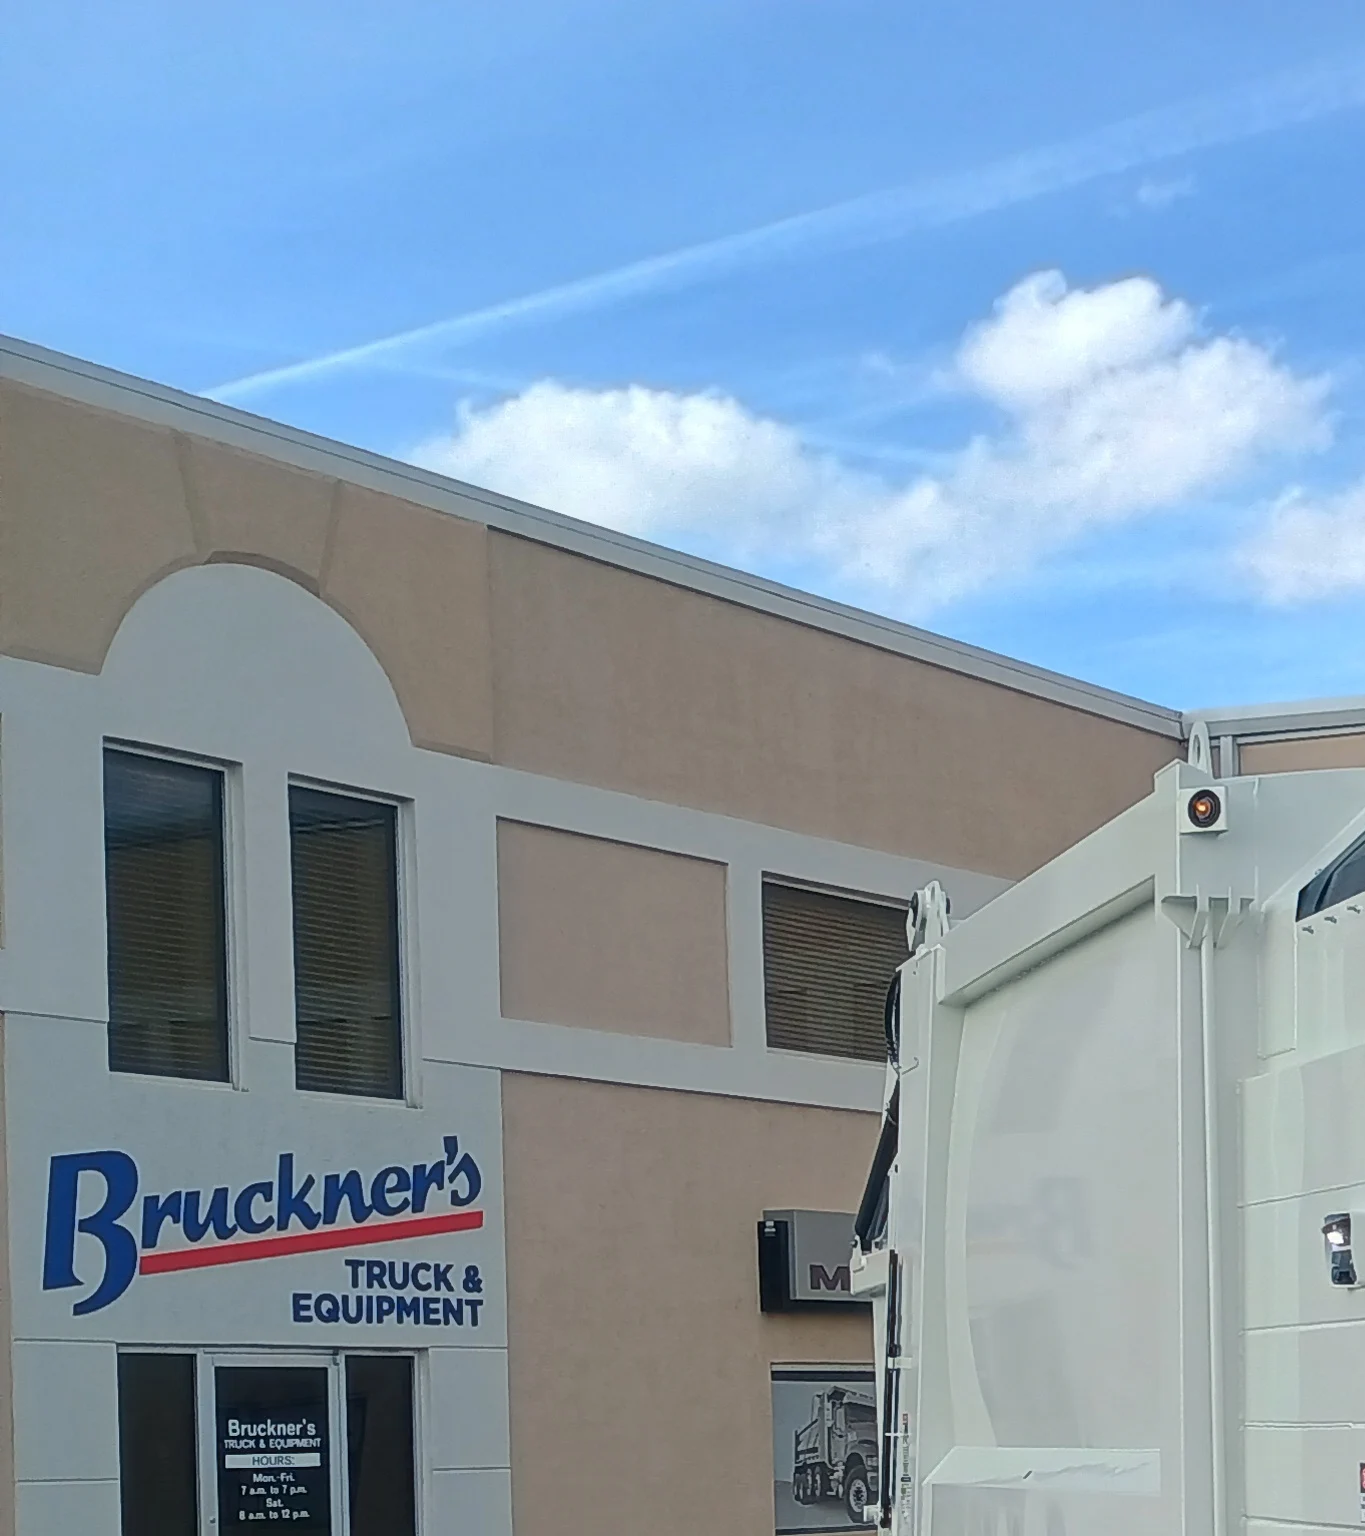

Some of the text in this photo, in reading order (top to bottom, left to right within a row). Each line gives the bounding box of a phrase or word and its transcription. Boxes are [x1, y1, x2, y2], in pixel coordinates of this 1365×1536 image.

[42, 1135, 482, 1317] Bruckner's
[344, 1258, 483, 1294] TRUCK &
[291, 1292, 483, 1328] EQUIPMENT
[227, 1418, 317, 1437] Bruckner's
[223, 1437, 322, 1451] TRUCK & EQUIPMENT
[251, 1455, 296, 1467] HOURS:
[241, 1485, 248, 1496] 7
[269, 1485, 280, 1495] to
[281, 1484, 288, 1494] 7
[268, 1510, 279, 1520] to
[281, 1508, 291, 1519] 12
